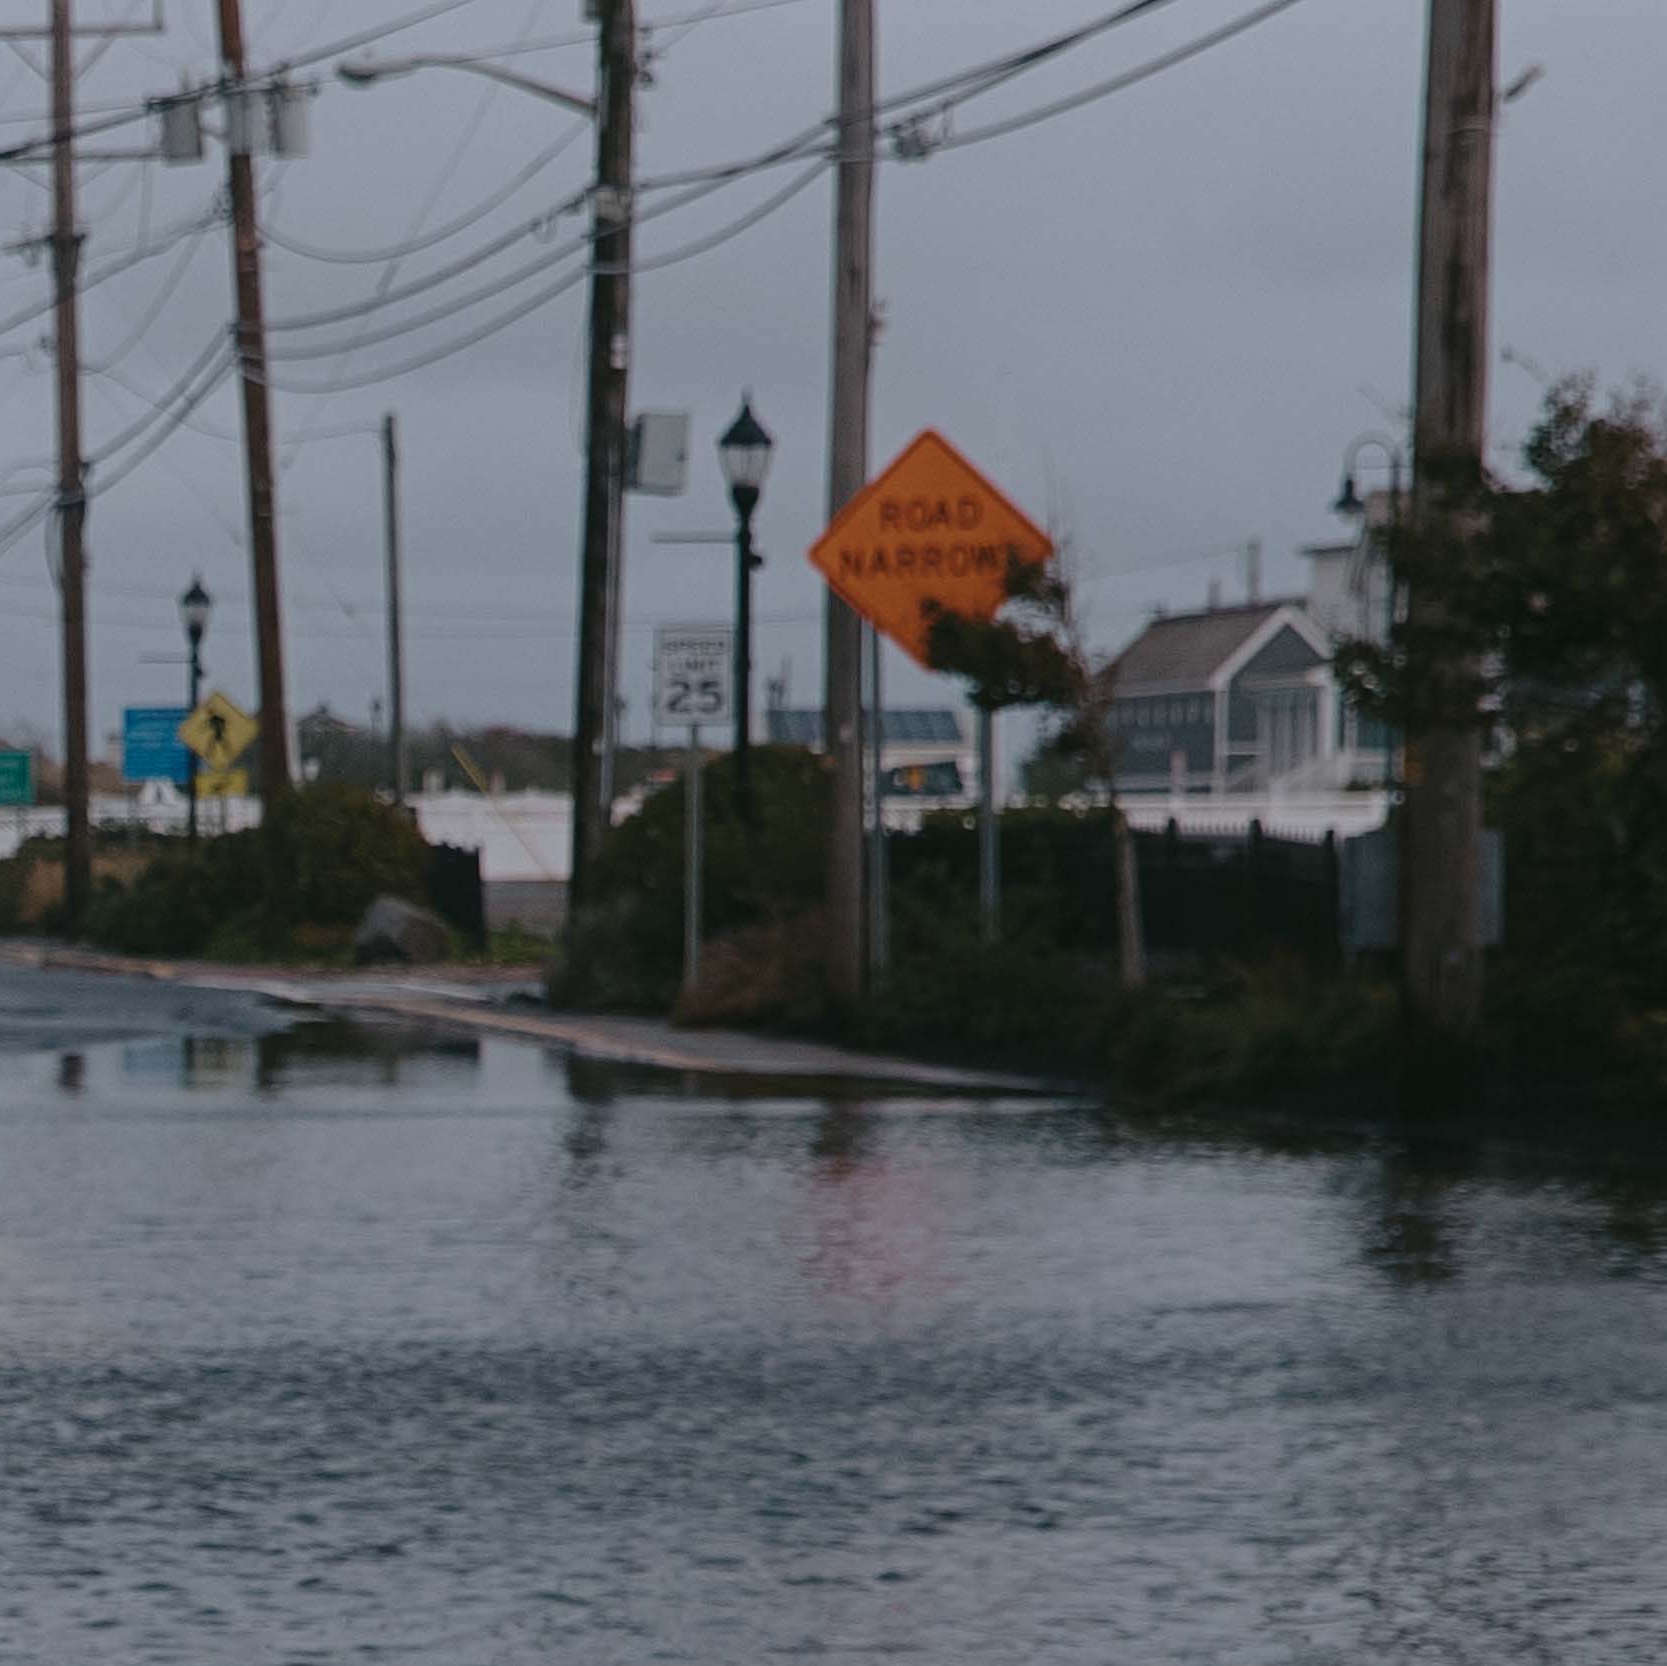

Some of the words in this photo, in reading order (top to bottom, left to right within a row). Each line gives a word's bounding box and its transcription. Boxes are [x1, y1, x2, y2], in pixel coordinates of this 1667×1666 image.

[880, 496, 984, 533] ROAD
[840, 543, 1014, 578] NARROW
[667, 679, 723, 714] 25
